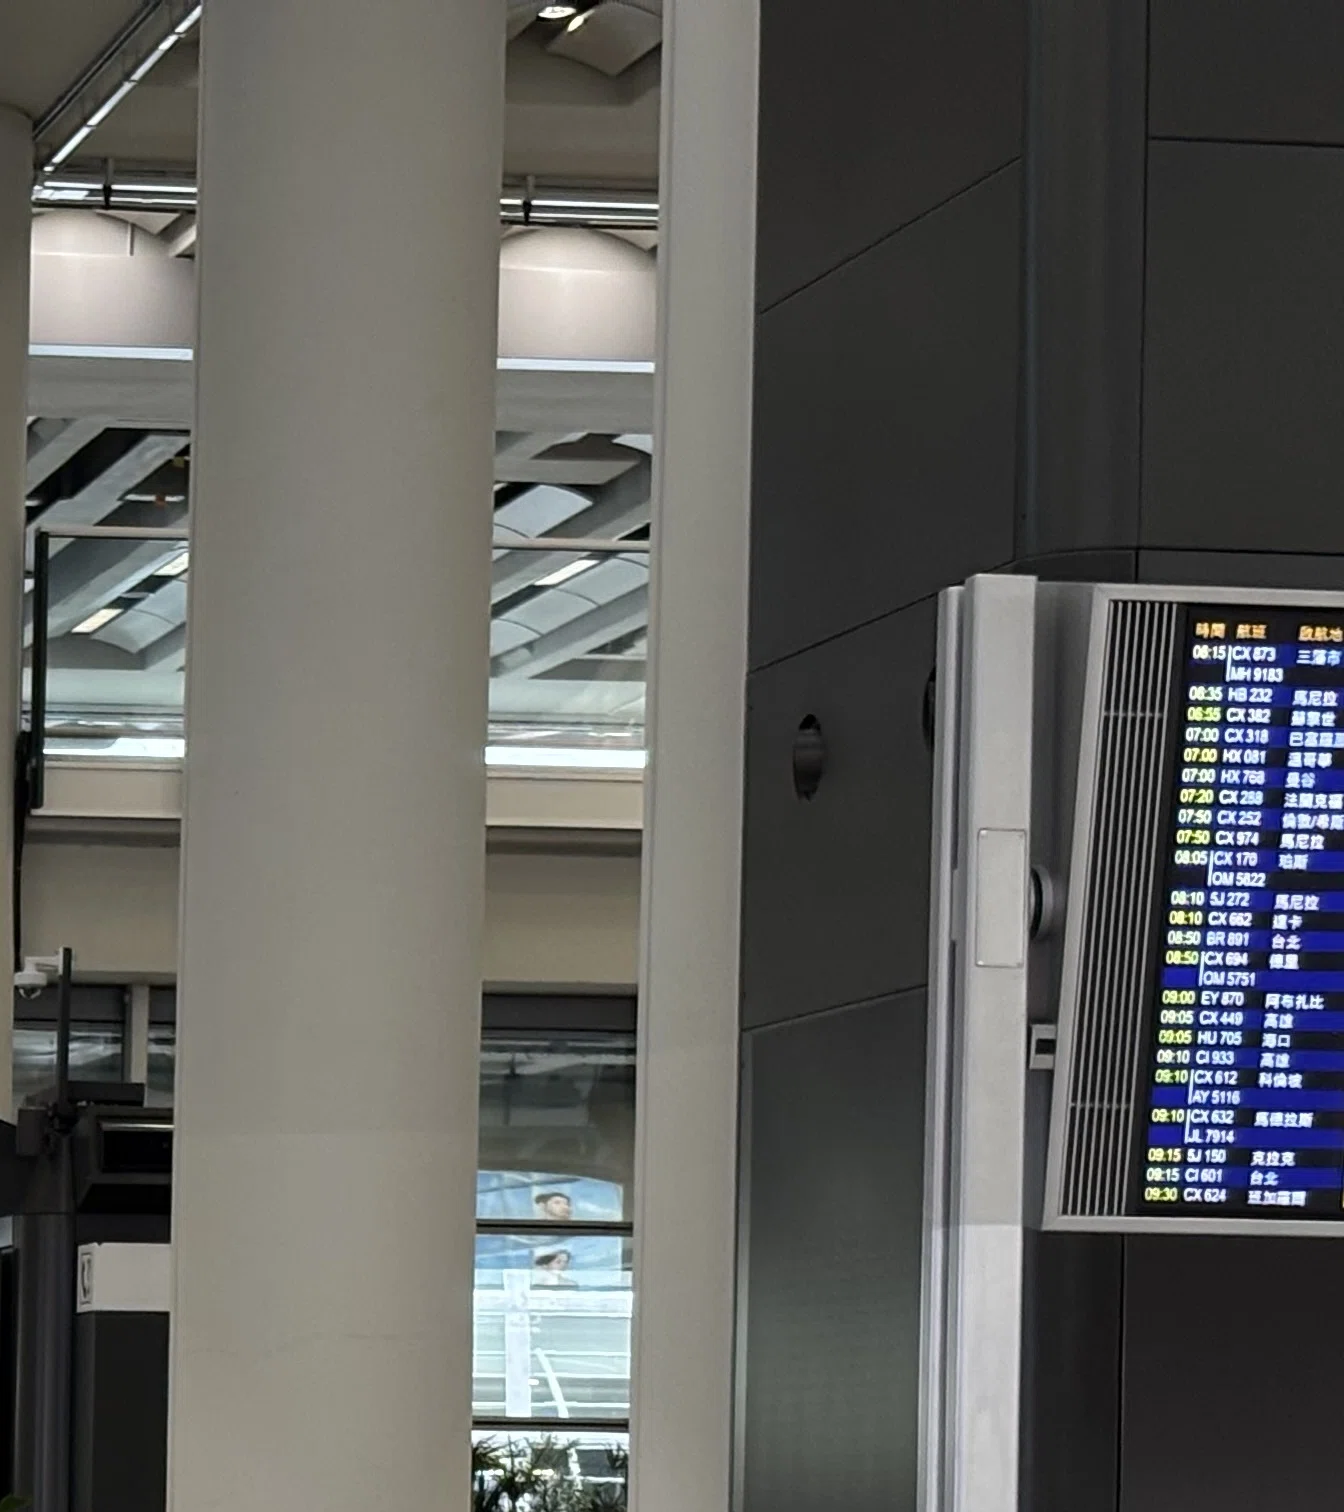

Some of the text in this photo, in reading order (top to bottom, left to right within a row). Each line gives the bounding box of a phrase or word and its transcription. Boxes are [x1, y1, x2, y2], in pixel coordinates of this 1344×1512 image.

[1233, 647, 1251, 660] CX
[1249, 689, 1272, 702] 232
[1227, 708, 1246, 722] CX
[1186, 728, 1219, 742] 07:00
[1225, 729, 1244, 743] CX
[1184, 749, 1241, 763] 07:00 HX
[1182, 769, 1240, 783] 07:00 HX
[1180, 789, 1238, 804] 07:20 CX
[1178, 809, 1212, 824] 07:50
[1217, 811, 1237, 824] CX
[1176, 830, 1210, 844] 07:50
[1215, 831, 1235, 845] CX
[1215, 852, 1232, 865] CX
[1227, 893, 1250, 906] 272
[1208, 913, 1227, 925] CX
[1205, 952, 1223, 965] CX
[1226, 972, 1255, 986] 5751
[1201, 991, 1219, 1004] EY
[1200, 1012, 1218, 1025] CX
[1198, 1032, 1242, 1046] HU 705
[1212, 1051, 1234, 1065] 933
[1195, 1071, 1238, 1085] CX 612
[1191, 1109, 1209, 1123] CX
[1148, 1149, 1226, 1163] 09:15 150
[1201, 1169, 1222, 1182] 601
[1145, 1188, 1226, 1203] 09:30 CX 624
